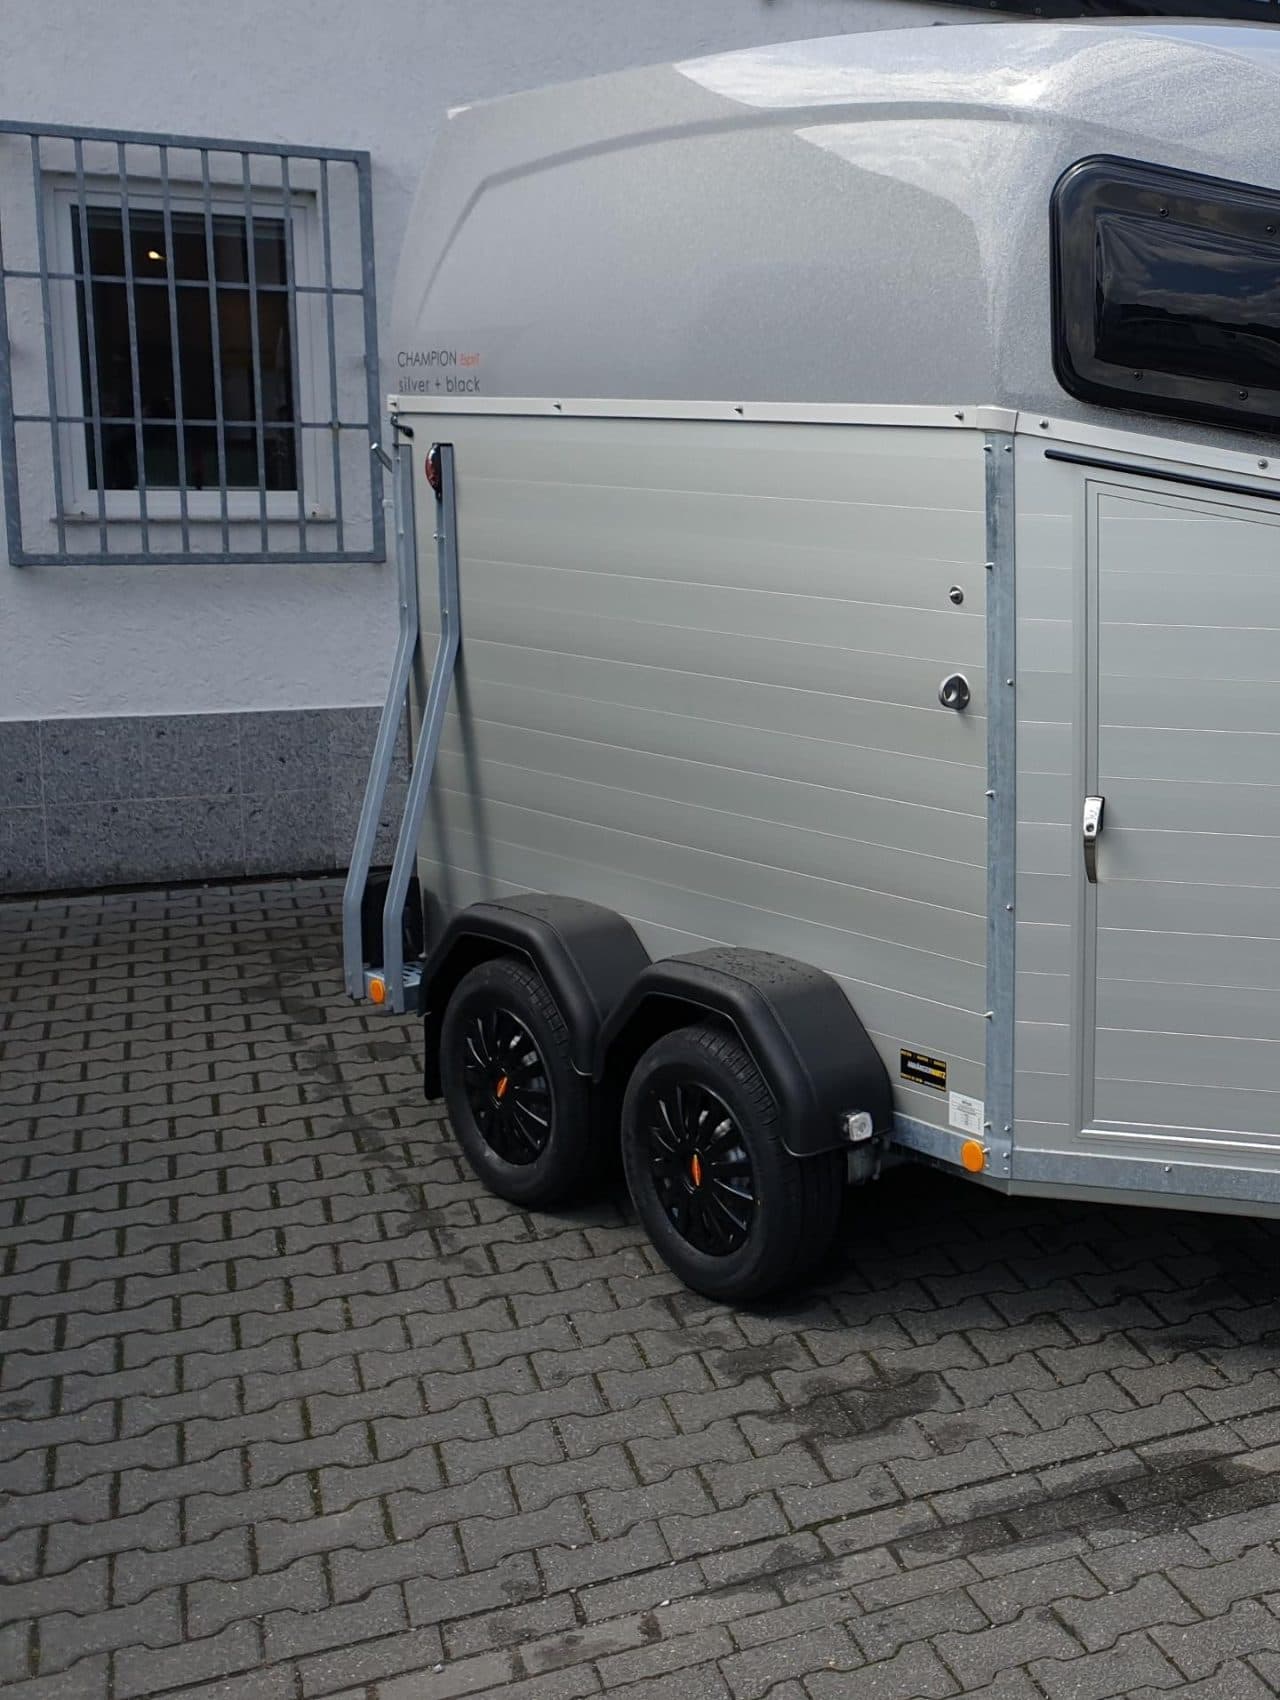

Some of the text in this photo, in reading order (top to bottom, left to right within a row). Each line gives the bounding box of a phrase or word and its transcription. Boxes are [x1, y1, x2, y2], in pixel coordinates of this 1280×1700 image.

[397, 350, 457, 368] CHAMPION
[399, 376, 430, 393] silver
[445, 376, 480, 393] black
